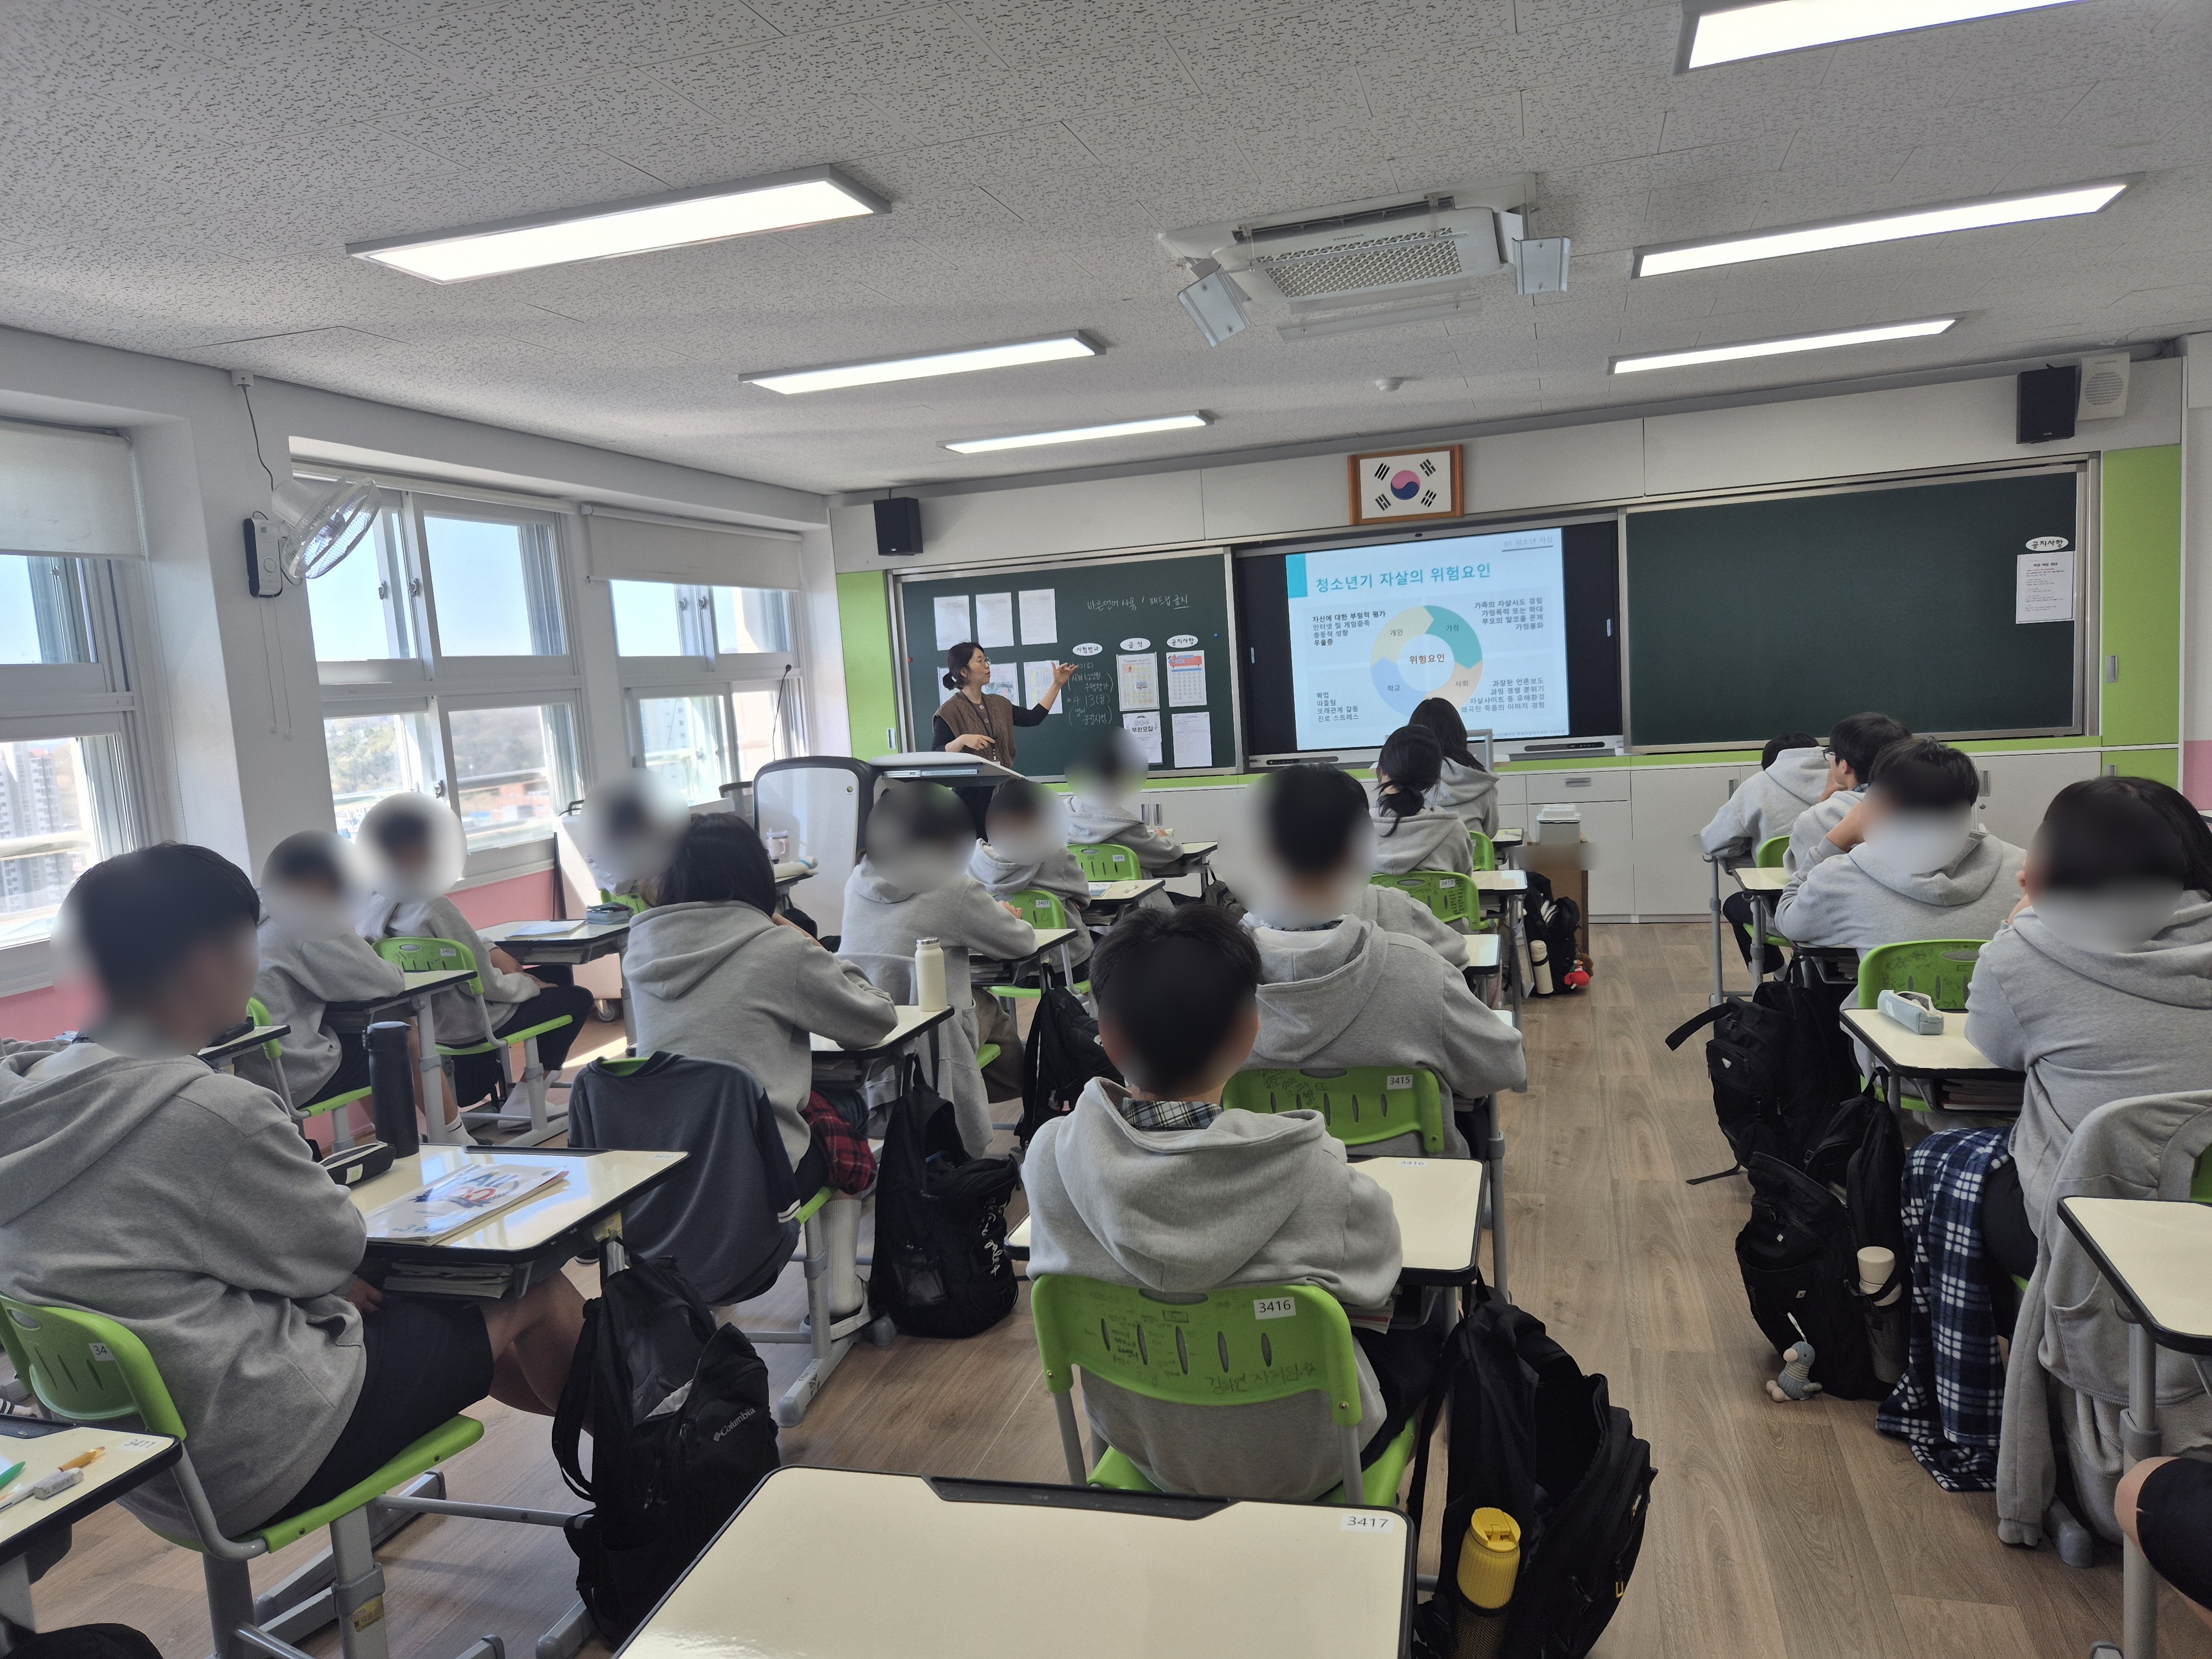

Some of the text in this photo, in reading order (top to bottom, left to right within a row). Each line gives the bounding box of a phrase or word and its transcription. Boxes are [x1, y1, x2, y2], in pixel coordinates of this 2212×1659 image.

[1515, 538, 1536, 546] 청소년
[1539, 535, 1553, 545] 자살
[2031, 539, 2063, 549] 공지사항
[1316, 562, 1491, 593] 청소년기 자살의 위험요인
[1122, 597, 1136, 610] 사용
[1173, 594, 1188, 606] 금지
[1498, 599, 1526, 607] 자살시도
[1350, 612, 1369, 620] 부정적
[1482, 608, 1509, 617] 가정폭력
[1505, 615, 1526, 623] 알코올
[1313, 623, 1332, 631] 인터넷
[1344, 620, 1370, 628] 게임중독
[1516, 622, 1543, 630] 가정불화
[1313, 630, 1333, 639] 충동적
[1314, 638, 1333, 646] 우울증
[1410, 653, 1445, 664] 위험요인
[1516, 677, 1544, 686] 언론보도
[1084, 682, 1109, 692] 수행평가
[1470, 696, 1504, 705] 자살사이트
[1517, 693, 1545, 702] 유해환경
[1389, 1076, 1410, 1085] 3415
[1259, 1300, 1291, 1313] 3416
[93, 1345, 108, 1355] 34
[721, 1407, 756, 1436] Columbia
[124, 1439, 156, 1448] 3411
[1347, 1516, 1389, 1528] 3417
